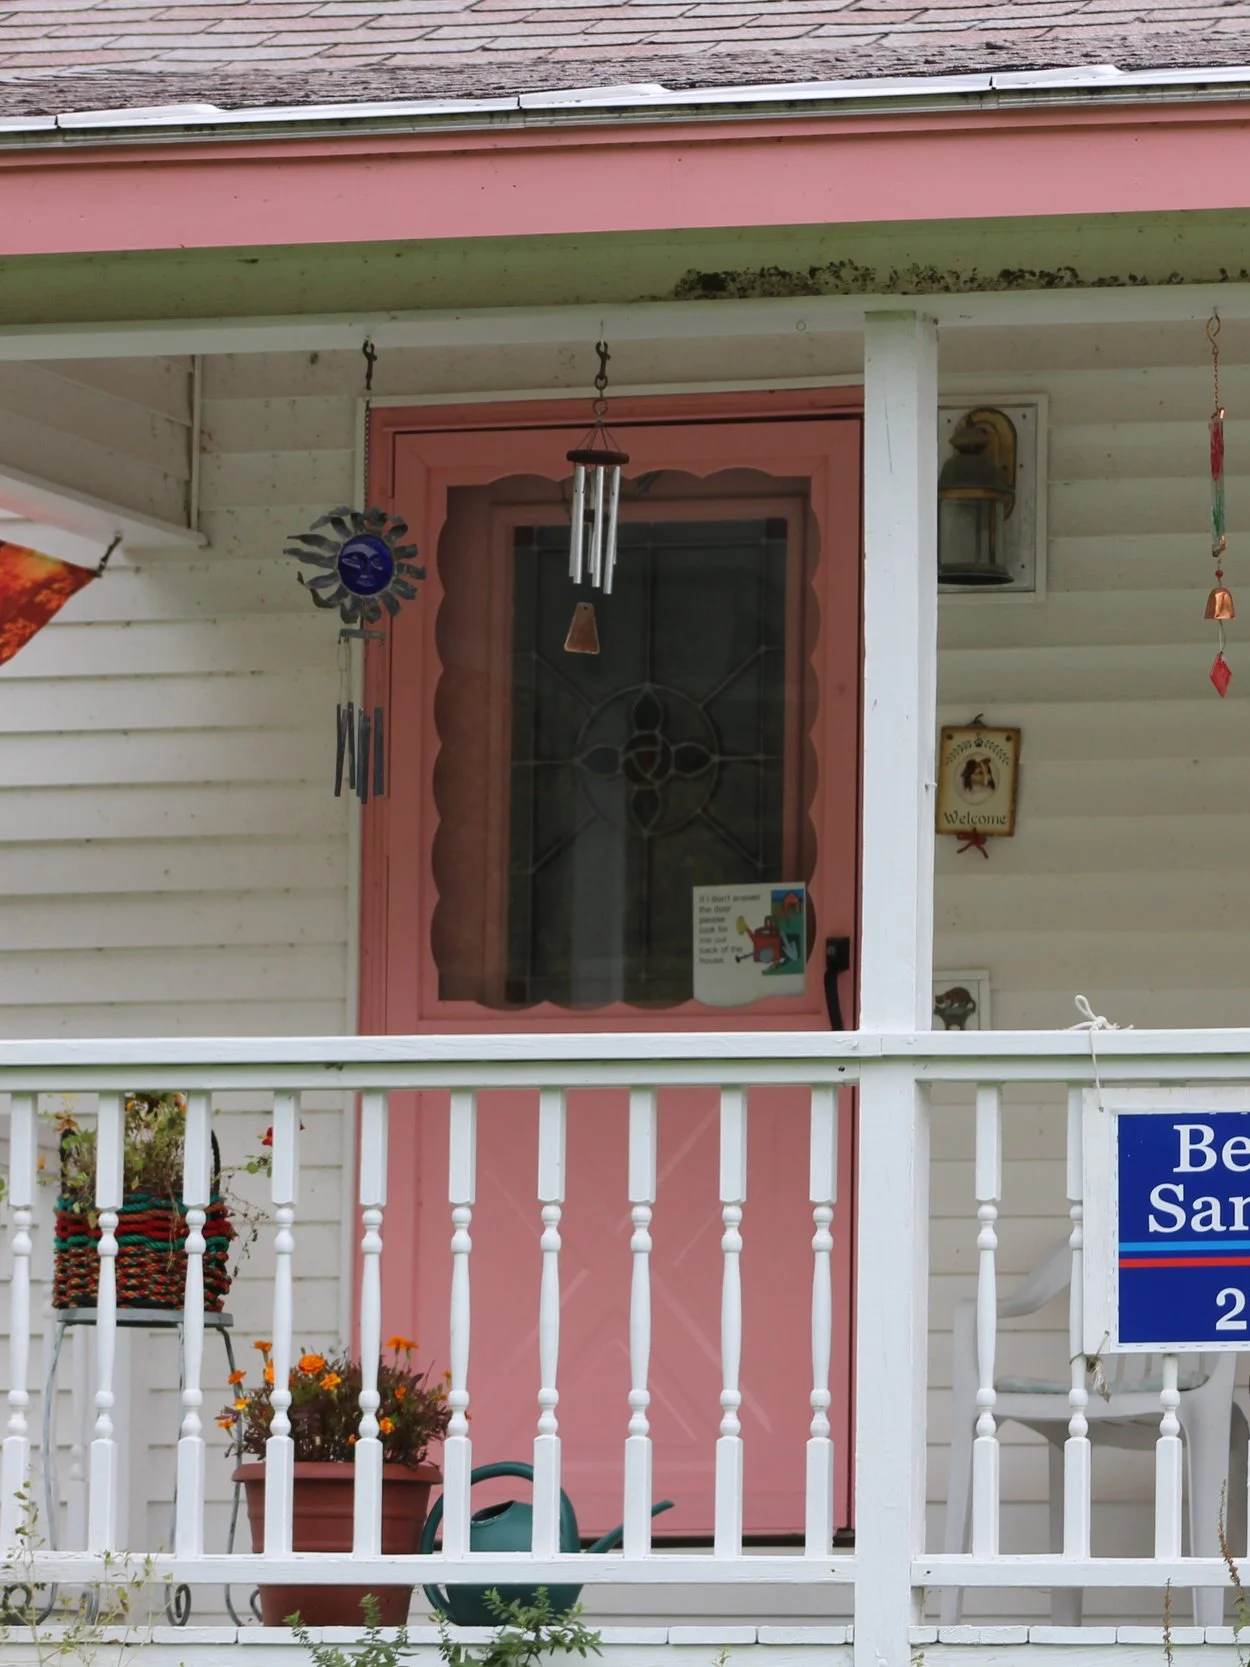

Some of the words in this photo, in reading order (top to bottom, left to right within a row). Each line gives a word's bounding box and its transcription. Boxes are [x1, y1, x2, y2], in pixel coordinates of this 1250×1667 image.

[943, 810, 1006, 825] Welcome
[699, 905, 712, 913] the
[714, 904, 732, 913] door
[699, 916, 725, 925] please
[731, 945, 743, 953] the
